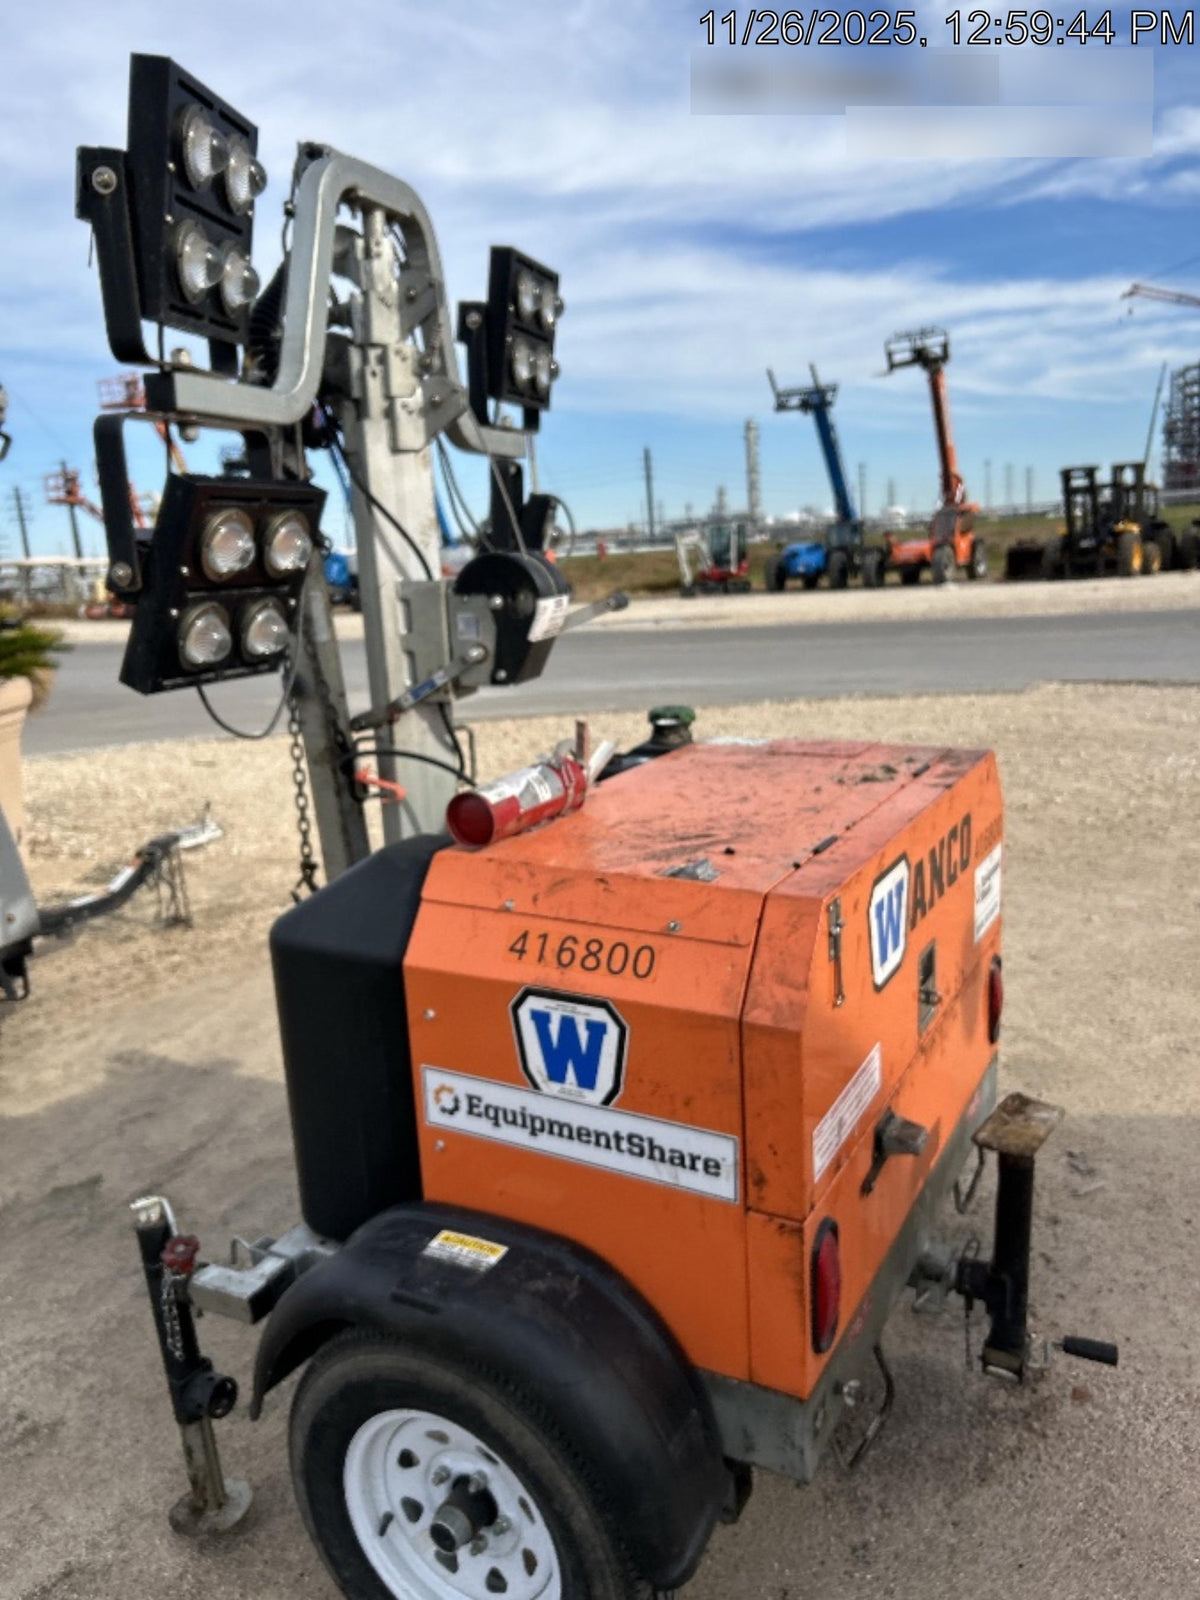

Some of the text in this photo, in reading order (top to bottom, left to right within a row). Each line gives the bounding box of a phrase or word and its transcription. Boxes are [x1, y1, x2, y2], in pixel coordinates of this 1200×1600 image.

[509, 930, 655, 978] 416800
[529, 1008, 607, 1091] W
[466, 1094, 721, 1177] EquipmentShare
